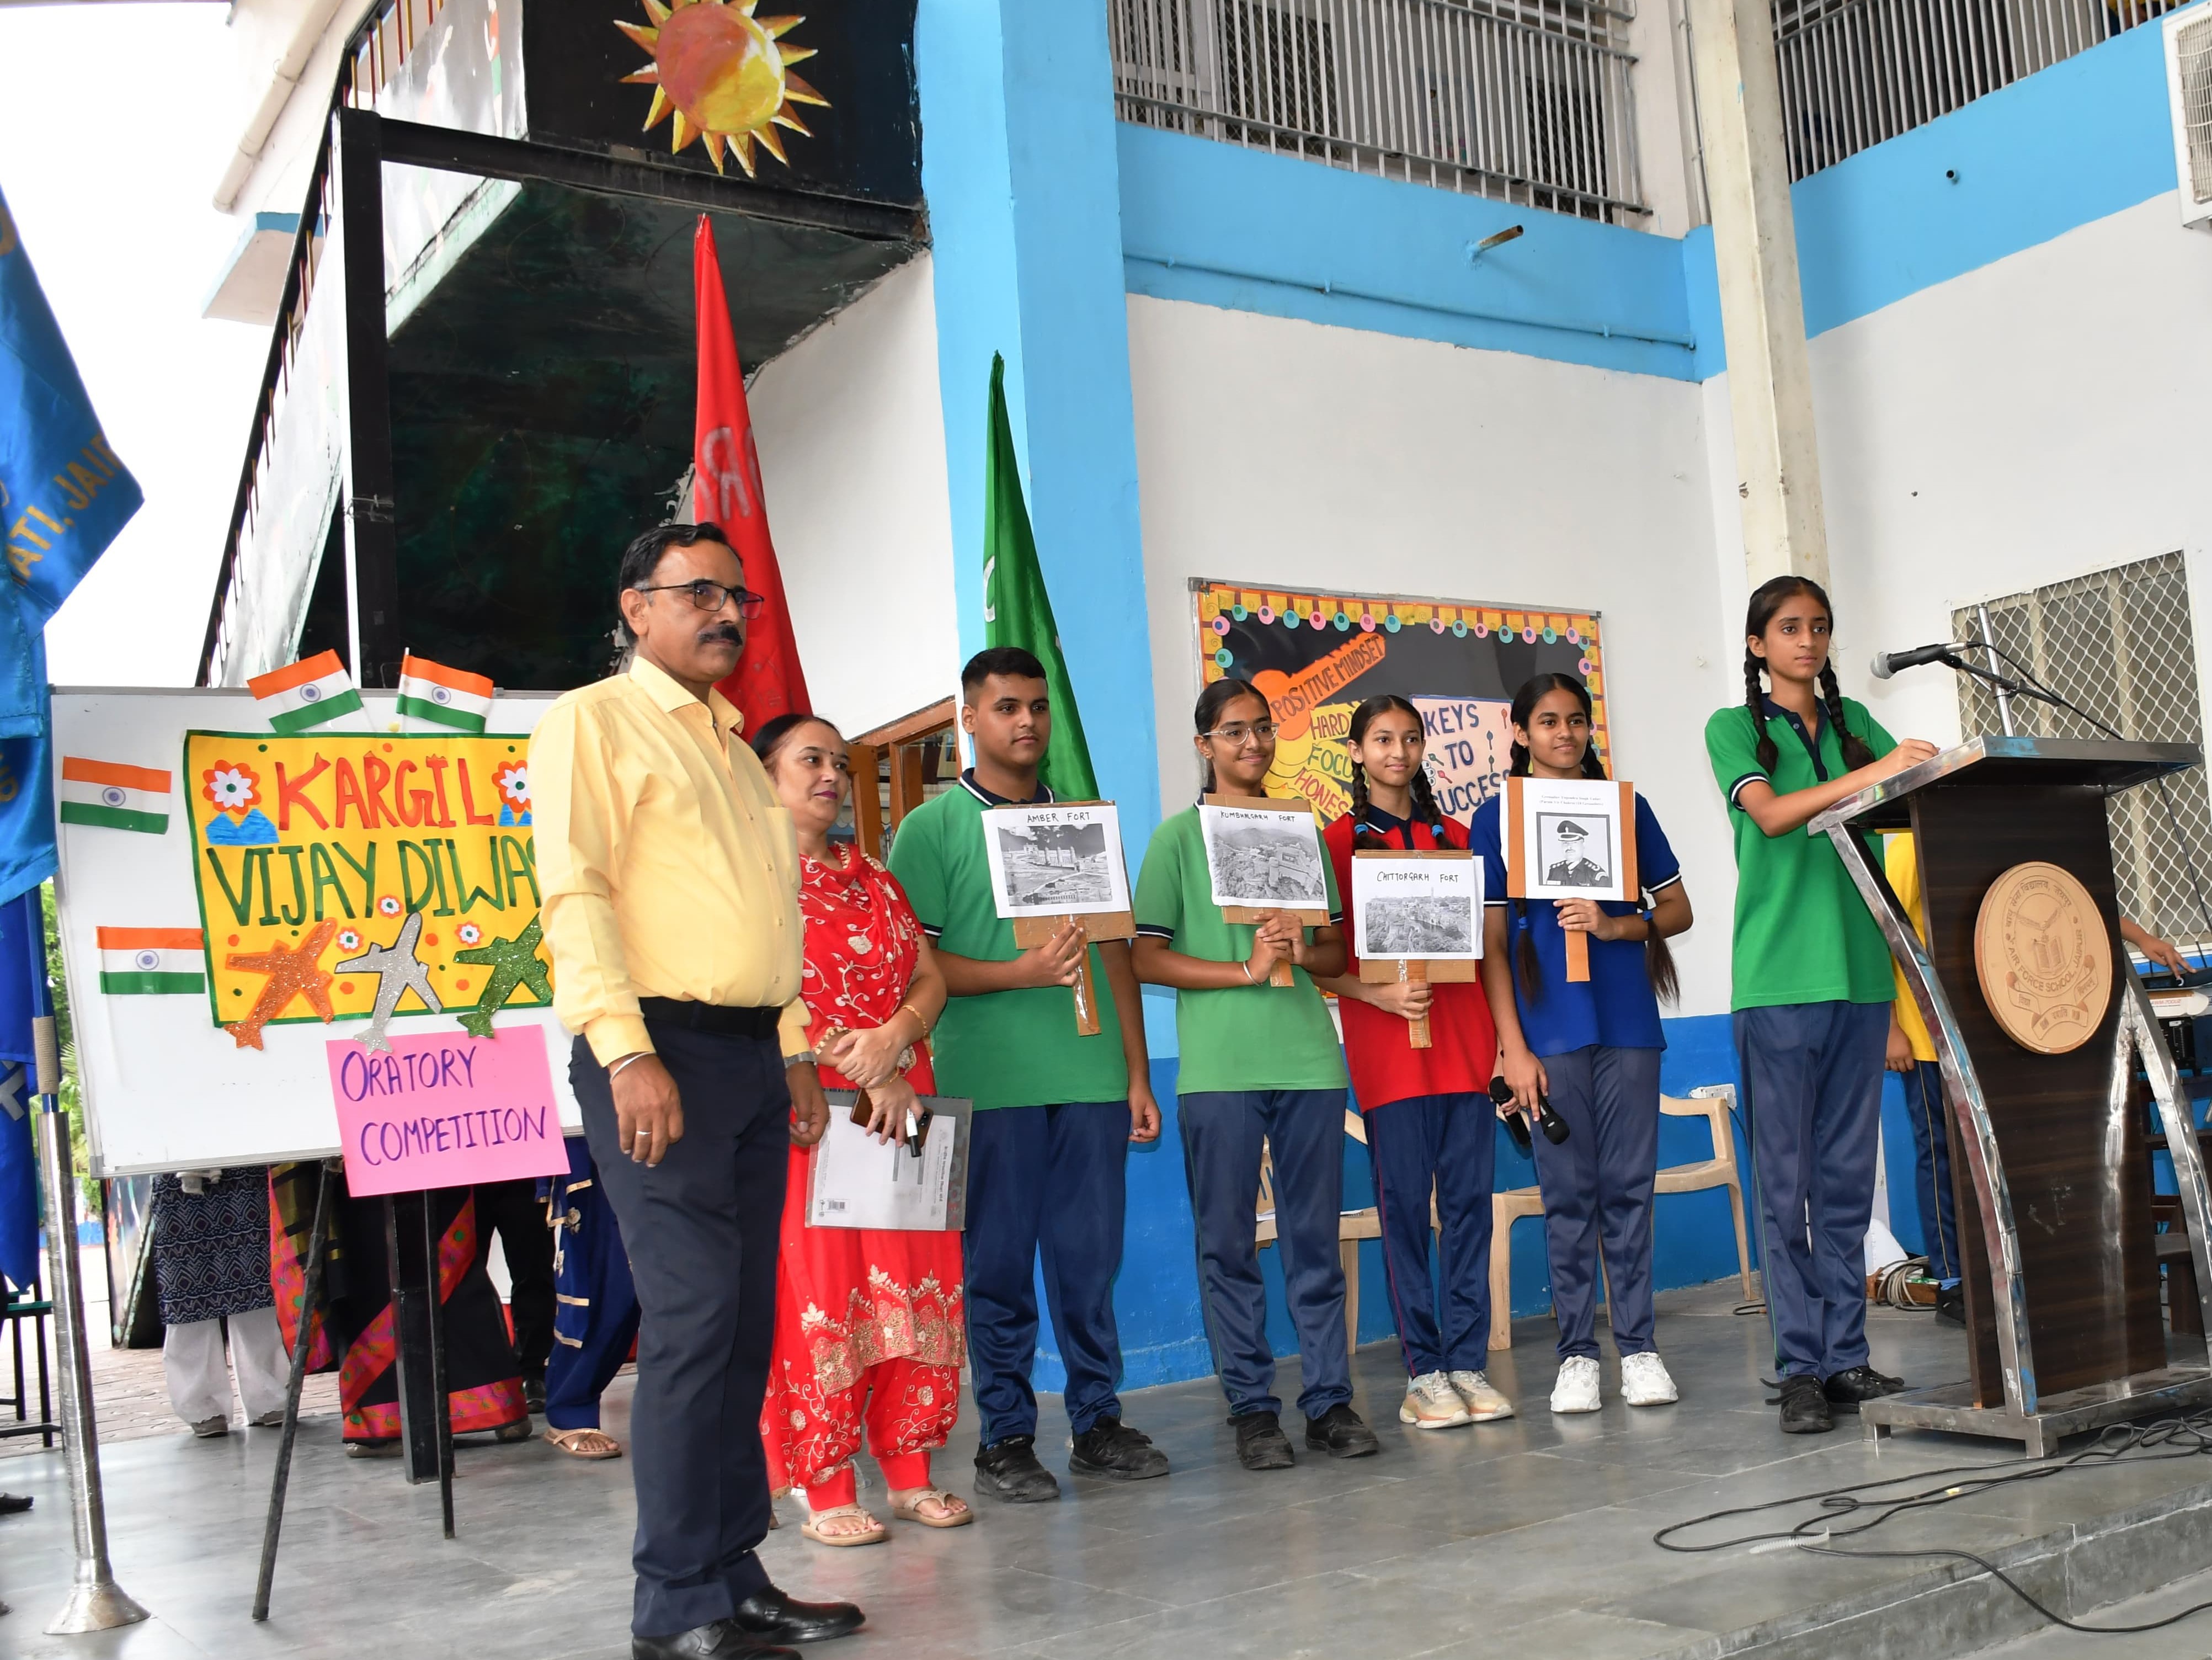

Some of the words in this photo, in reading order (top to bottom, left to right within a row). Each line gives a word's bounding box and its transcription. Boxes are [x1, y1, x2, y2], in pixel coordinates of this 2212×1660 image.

[1270, 666, 1339, 722] POSITIVE
[1333, 635, 1384, 682] MINDSET
[1309, 712, 1350, 740] HARD
[1423, 703, 1479, 737] KEYS
[1444, 741, 1474, 770] TO
[275, 751, 494, 831] KARGIL
[1433, 769, 1511, 816] UCCES
[1027, 813, 1059, 823] AMBER
[1067, 812, 1090, 822] FORT
[206, 840, 377, 927] VIJAY
[397, 835, 541, 917] DIWA
[1377, 871, 1430, 881] CHITTORGARH
[1440, 874, 1459, 882] FORT
[2008, 947, 2020, 966] AIR
[2018, 965, 2044, 991] FORCE
[2074, 929, 2082, 968] JAIPUR
[341, 1046, 476, 1102] ORATORY
[360, 1106, 546, 1166] COMPETITION
